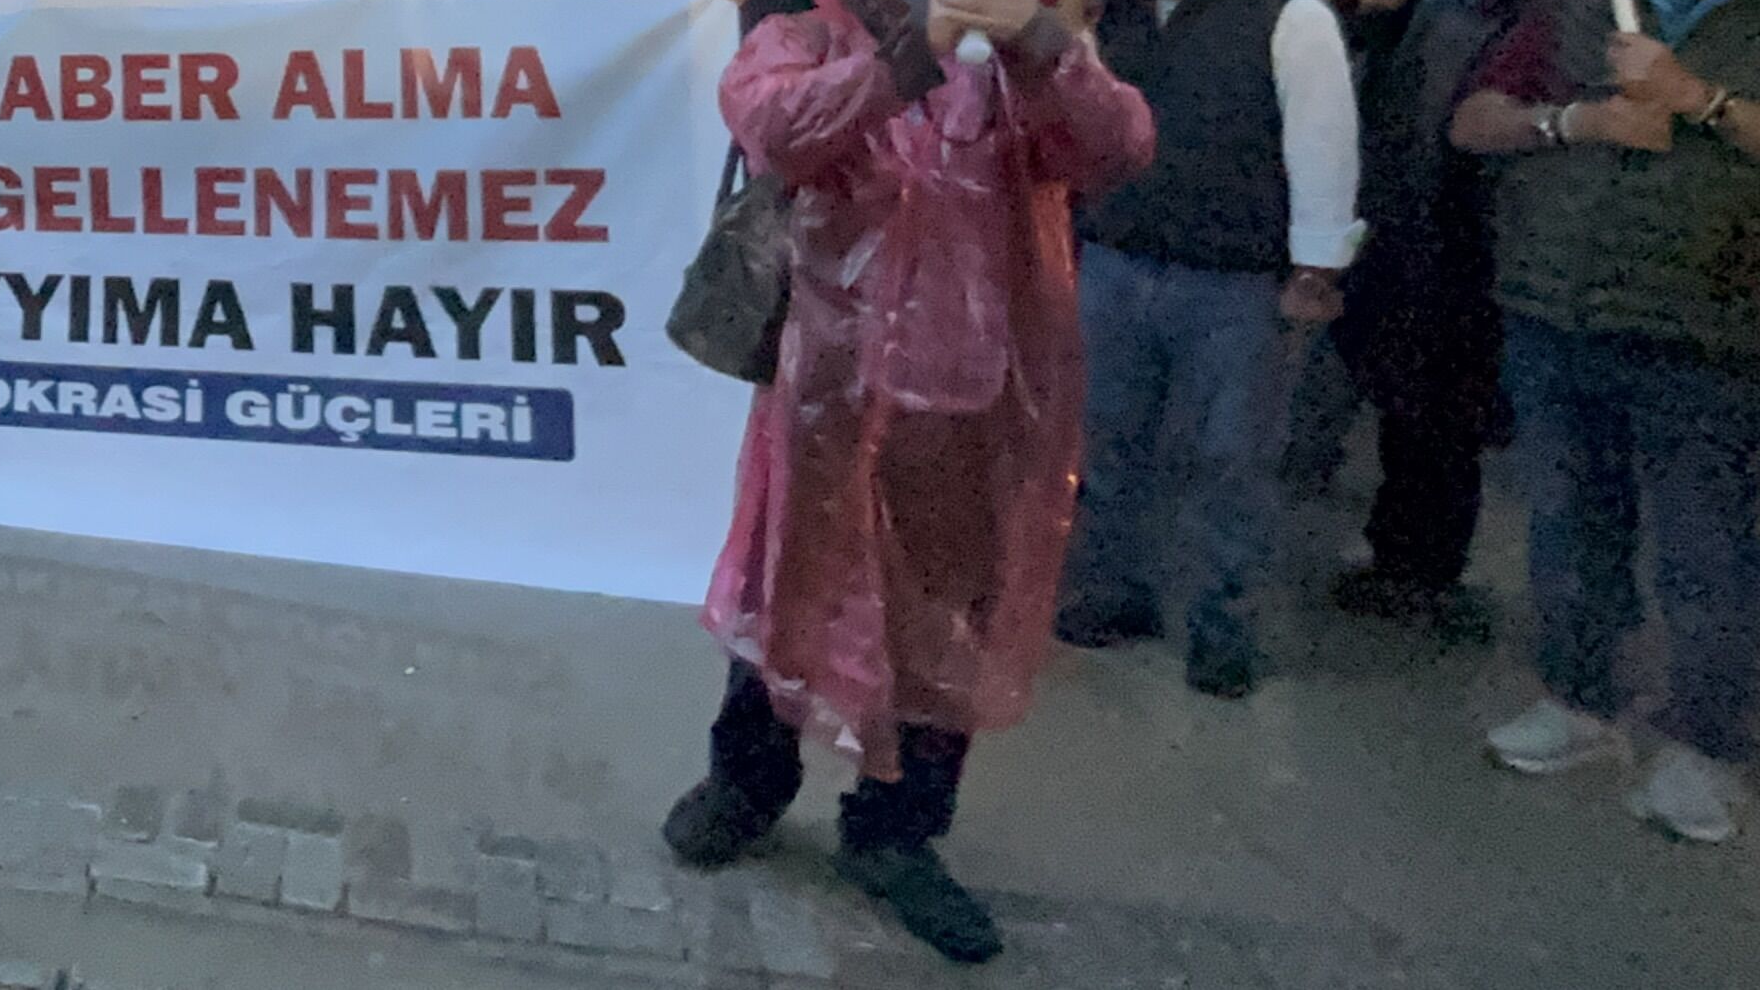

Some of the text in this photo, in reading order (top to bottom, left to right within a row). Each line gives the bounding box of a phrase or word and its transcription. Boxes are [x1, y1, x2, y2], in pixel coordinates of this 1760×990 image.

[272, 46, 562, 120] ALMA
[289, 282, 627, 368] HAYIR
[224, 383, 533, 444] GÜÇLERİ
